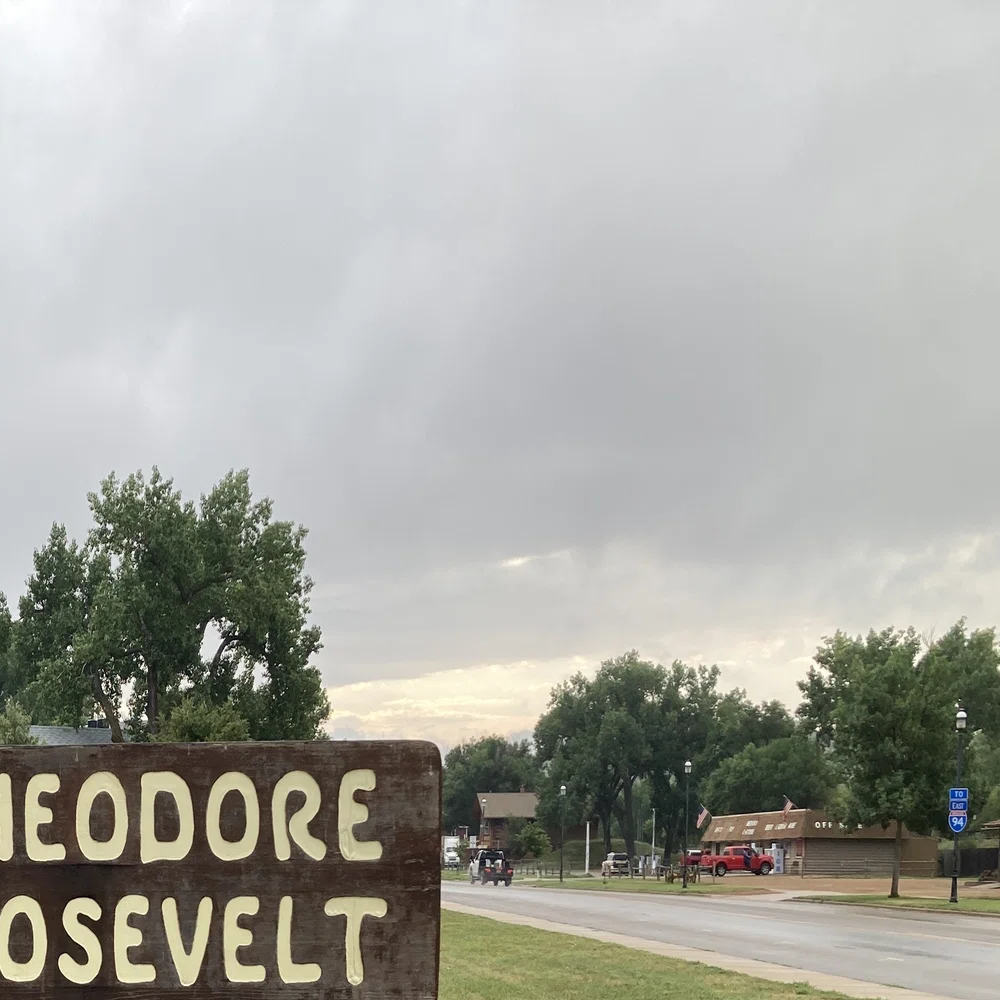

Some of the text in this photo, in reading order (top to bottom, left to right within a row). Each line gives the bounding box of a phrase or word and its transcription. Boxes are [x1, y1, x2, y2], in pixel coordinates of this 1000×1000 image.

[954, 790, 964, 798] TO
[951, 802, 965, 810] EAST
[814, 821, 833, 829] OFF
[951, 816, 964, 827] 94
